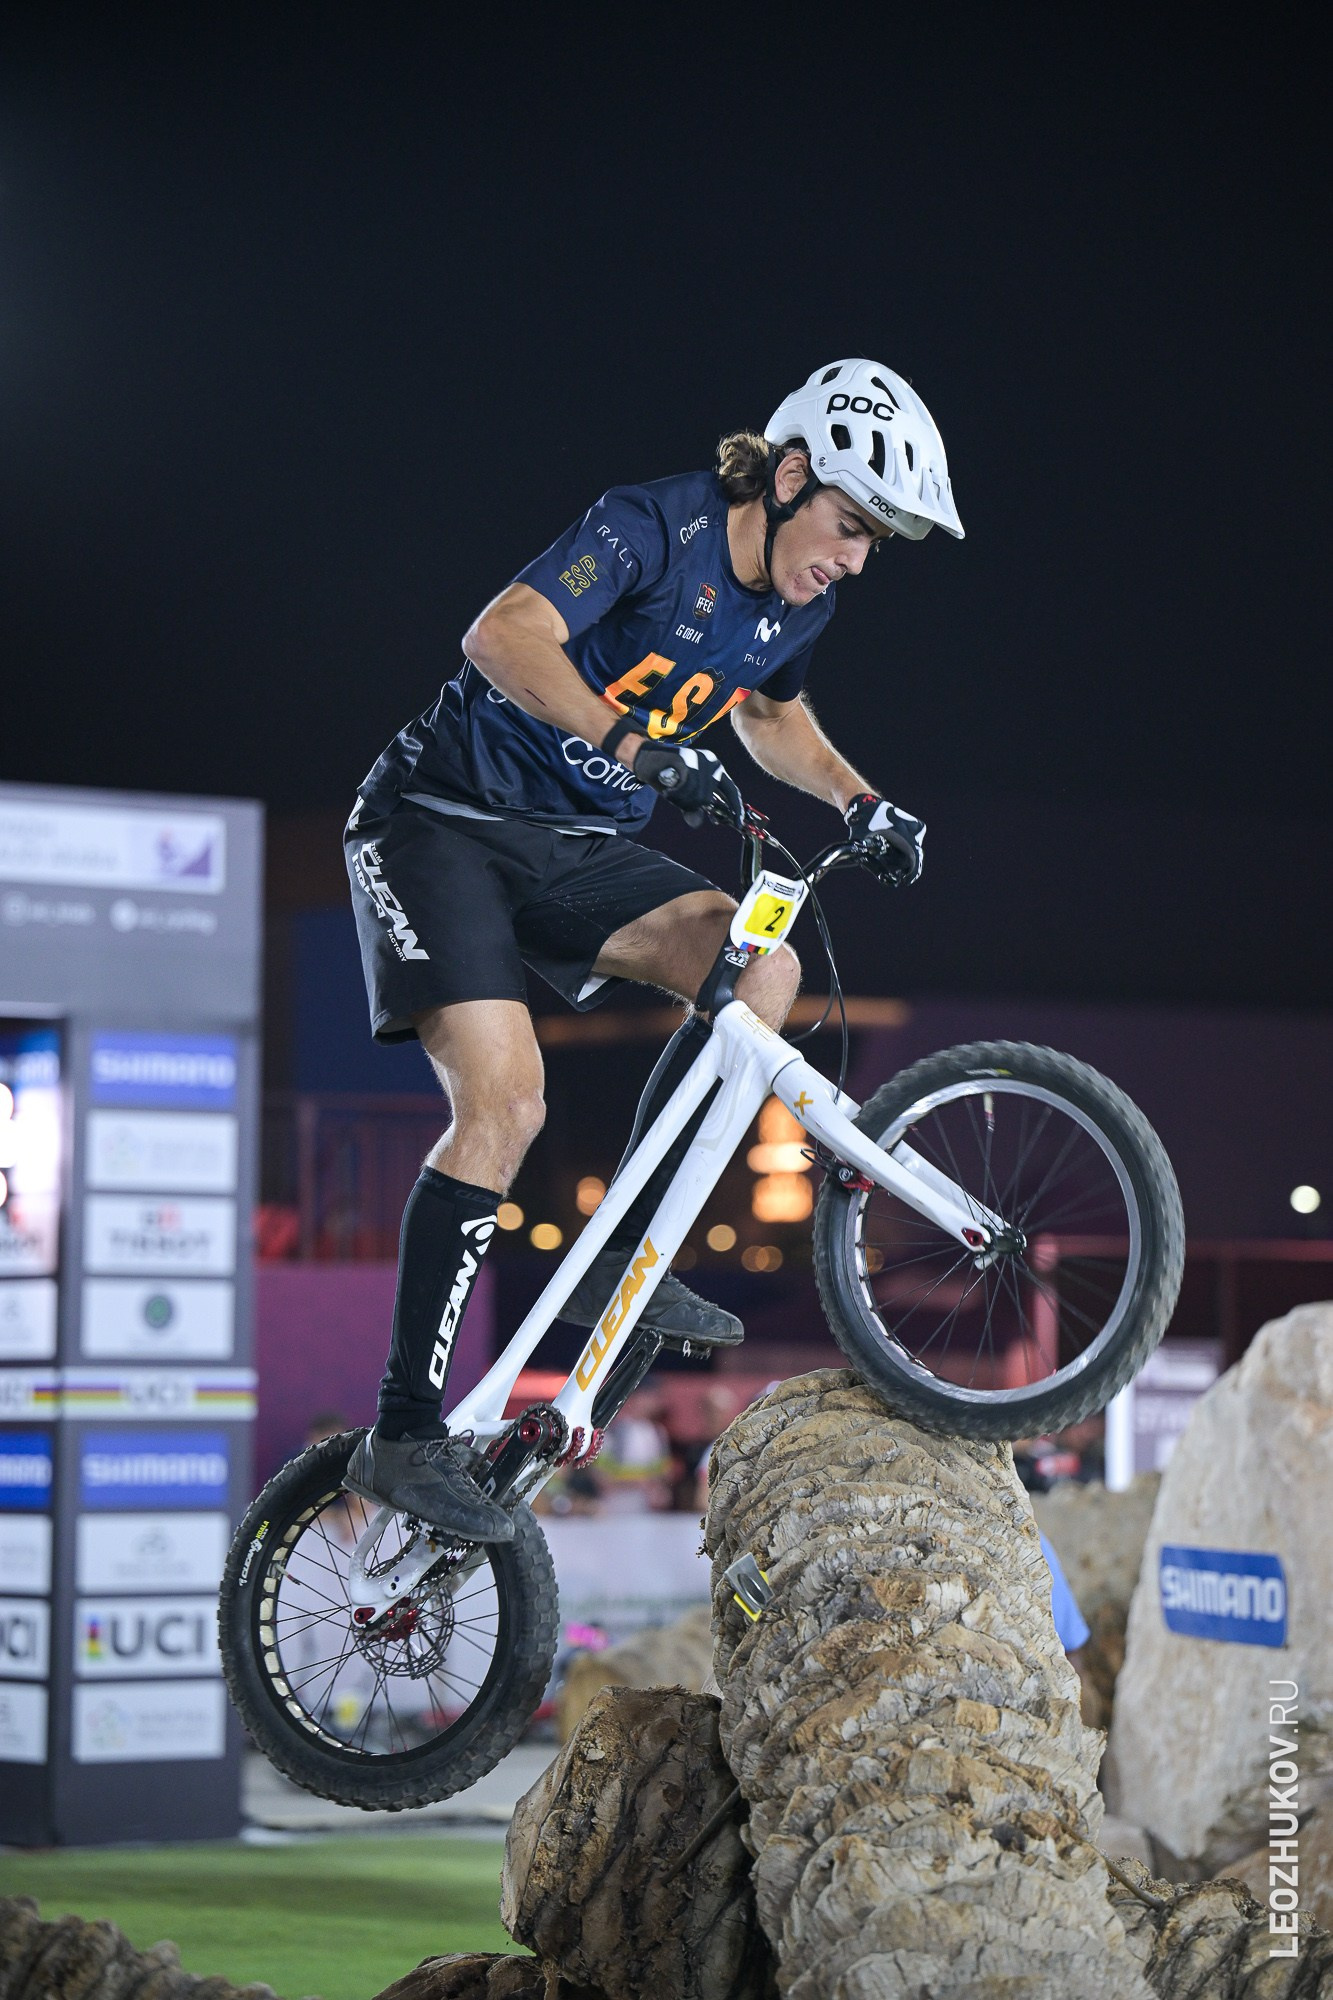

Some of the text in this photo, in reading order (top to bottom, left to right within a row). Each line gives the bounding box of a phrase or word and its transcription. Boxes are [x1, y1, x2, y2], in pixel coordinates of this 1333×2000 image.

[558, 555, 598, 598] ESP
[360, 843, 431, 960] CLEAN
[764, 906, 785, 932] 2
[387, 928, 408, 963] FACTORY
[428, 1249, 478, 1391] CLEAN
[575, 1235, 660, 1393] CLEAN
[1160, 1566, 1283, 1622] SHIMANO
[110, 1614, 205, 1658] UCI
